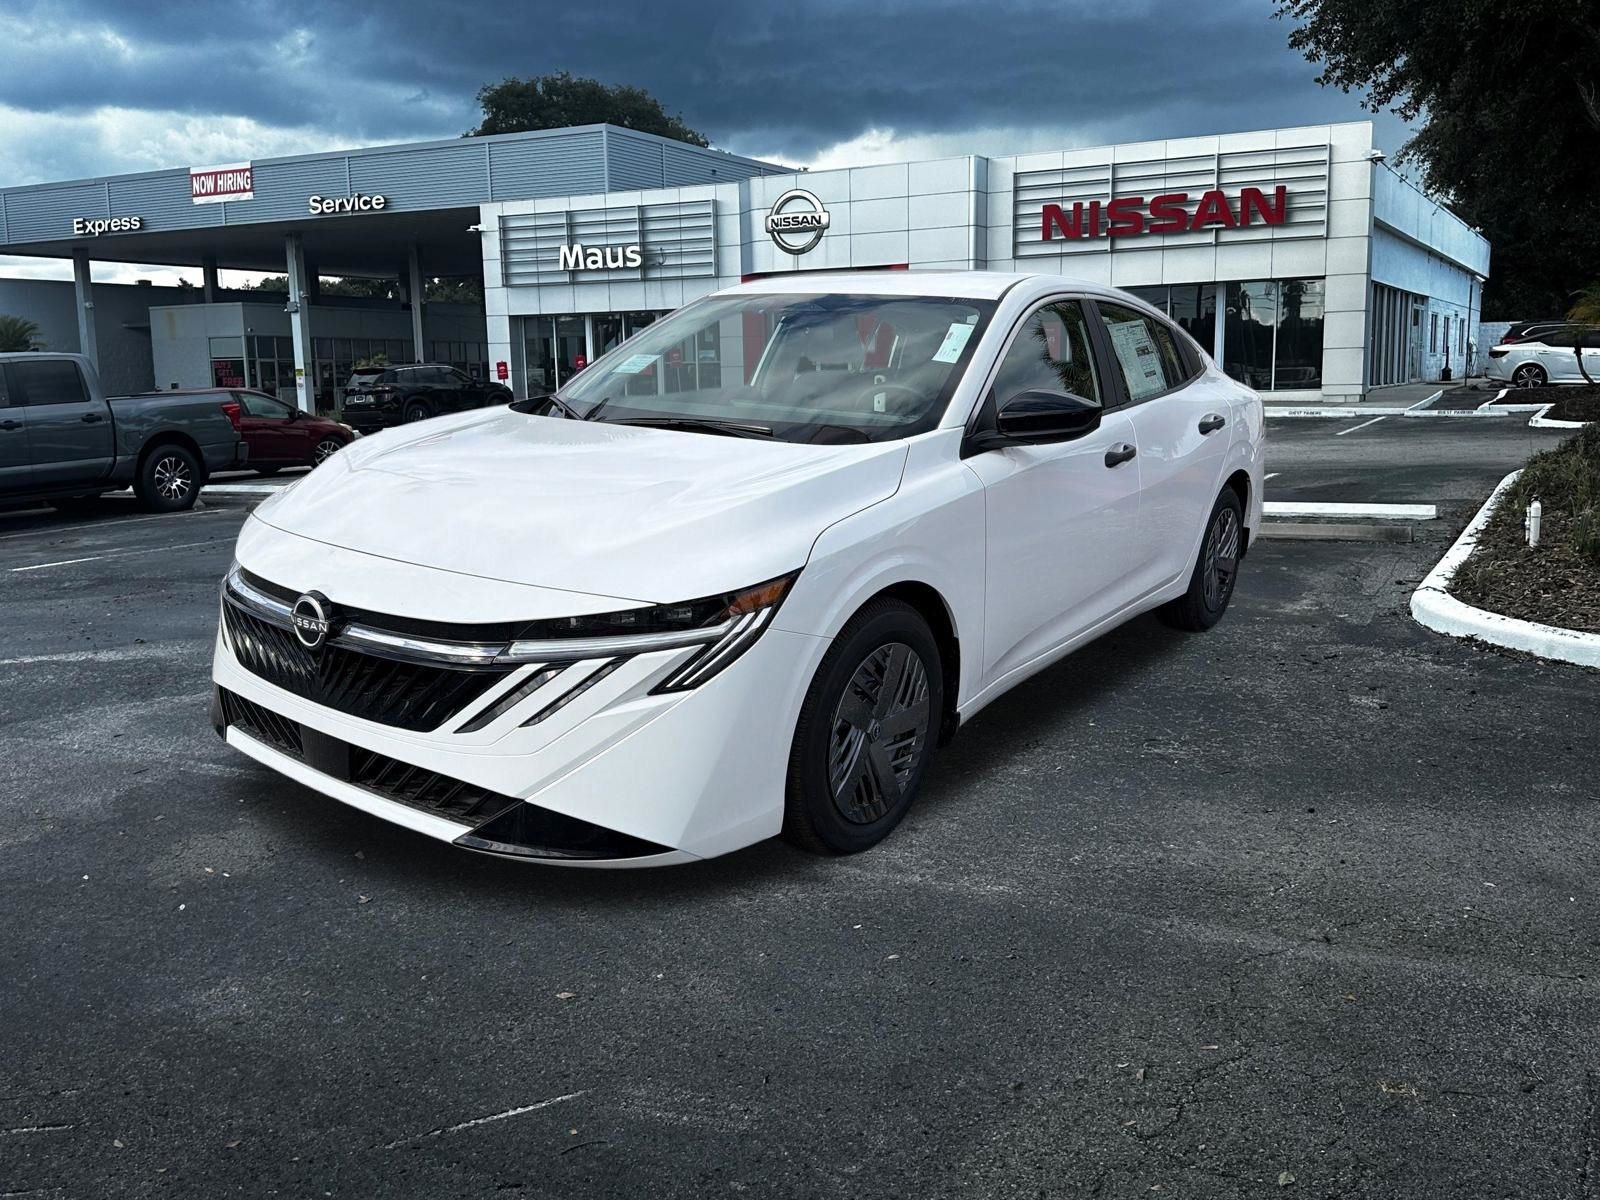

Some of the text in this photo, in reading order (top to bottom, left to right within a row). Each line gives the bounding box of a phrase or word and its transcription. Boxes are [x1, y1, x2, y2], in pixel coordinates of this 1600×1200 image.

[192, 171, 251, 195] NOW HIRING
[308, 193, 385, 214] Service
[1042, 185, 1287, 241] NISSAN
[73, 216, 141, 236] Express
[770, 214, 822, 229] NISSAN
[559, 243, 642, 271] Maus
